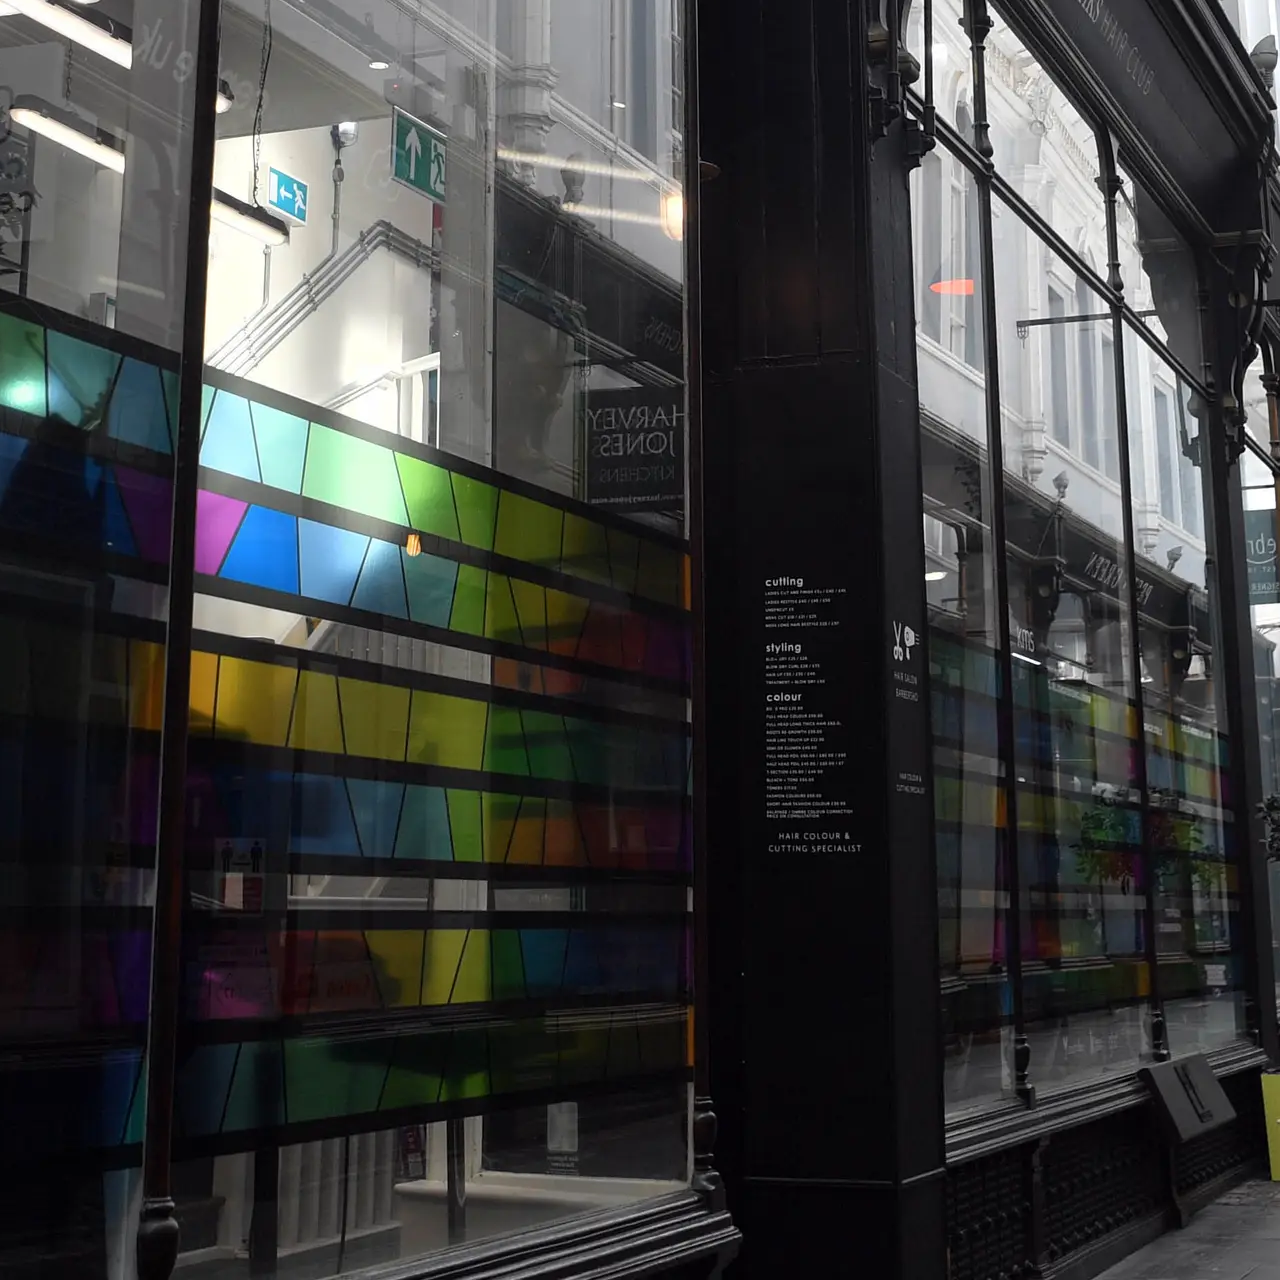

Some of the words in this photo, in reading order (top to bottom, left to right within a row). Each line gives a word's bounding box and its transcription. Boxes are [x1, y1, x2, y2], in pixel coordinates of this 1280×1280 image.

[1100, 8, 1128, 61] HAIR
[1126, 46, 1156, 95] CLUB
[765, 576, 804, 588] cutting
[765, 642, 802, 654] styling
[766, 692, 802, 702] colour
[778, 832, 800, 840] HAIR
[803, 832, 841, 840] COLOUR
[768, 844, 808, 853] CUTTING
[811, 843, 862, 853] SPECIALIST
